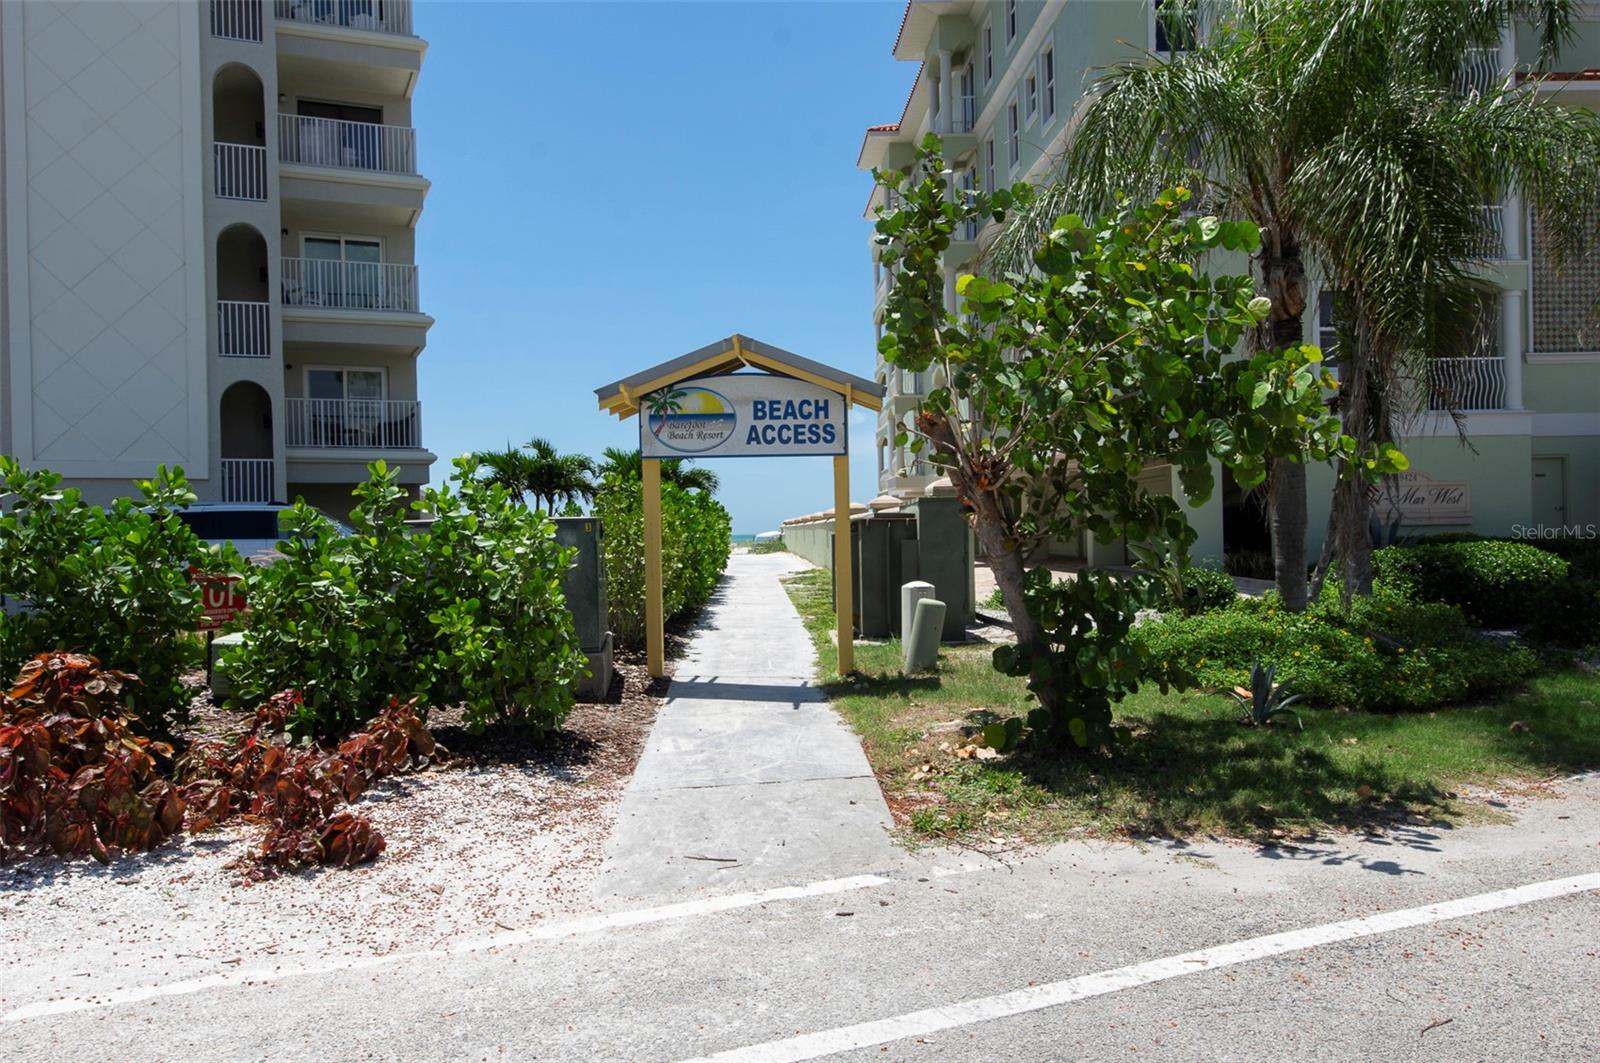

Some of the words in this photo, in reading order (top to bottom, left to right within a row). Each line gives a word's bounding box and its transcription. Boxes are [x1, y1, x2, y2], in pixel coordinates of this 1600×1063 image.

[753, 399, 829, 420] BEACH
[667, 420, 706, 432] Barefoot
[746, 423, 836, 445] ACCESS
[667, 430, 694, 440] Beach
[695, 430, 724, 441] Resort
[1429, 487, 1464, 505] West
